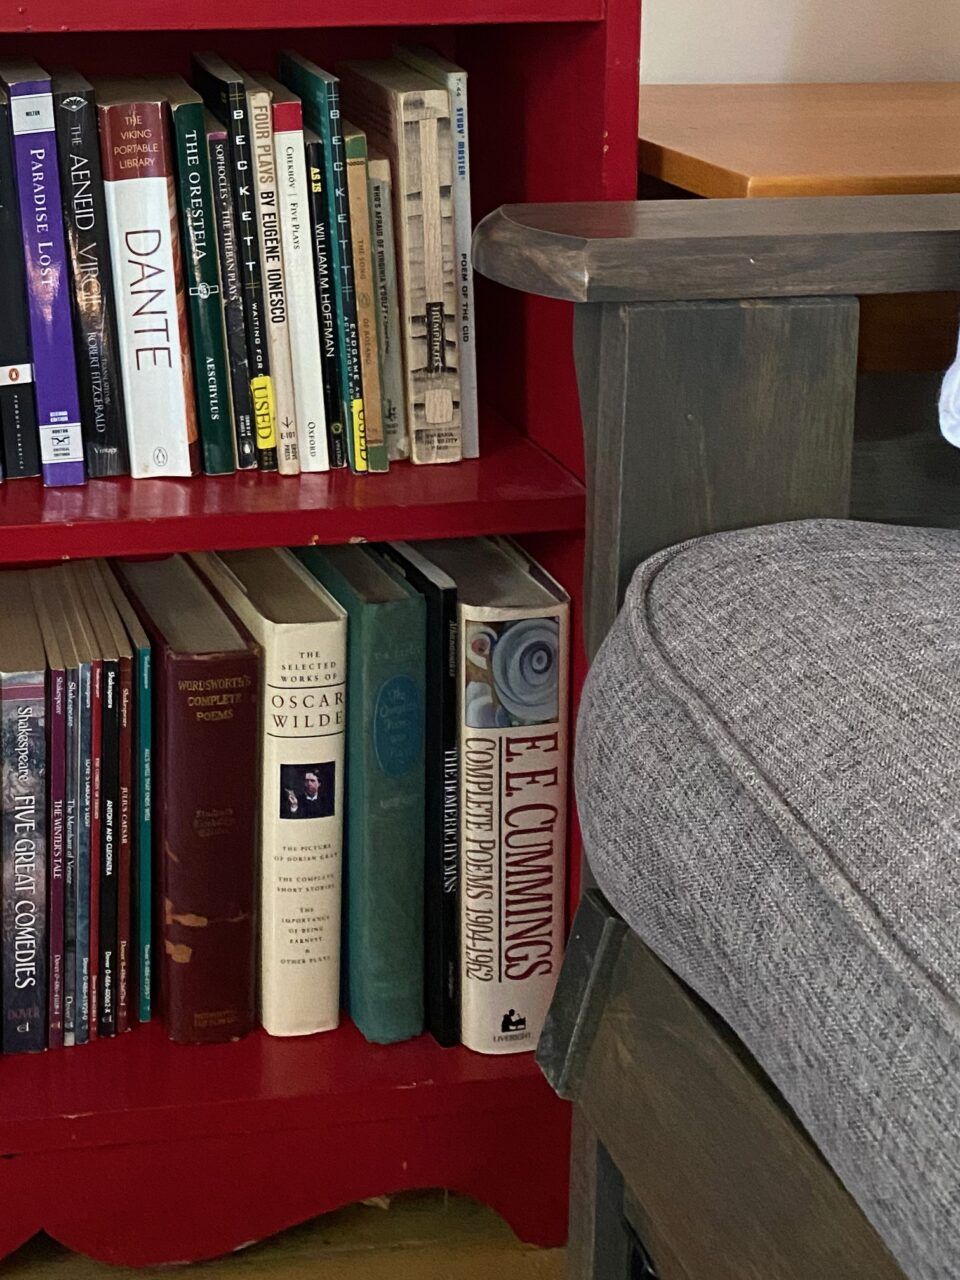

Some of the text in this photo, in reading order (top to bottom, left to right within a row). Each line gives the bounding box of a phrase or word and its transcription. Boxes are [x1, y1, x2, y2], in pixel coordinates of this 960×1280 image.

[112, 142, 160, 156] PORTABLE
[120, 128, 152, 140] VIKING
[125, 114, 143, 126] THE
[69, 153, 96, 231] AENEID
[118, 156, 156, 169] LIBRARY
[184, 130, 207, 261] THE ORESTEIA
[30, 149, 60, 286] PARADISE LOST
[253, 105, 286, 325] FOUR PLAYS BY EUGENE IONESCO
[125, 229, 173, 371] DANTE
[205, 356, 220, 420] AESCHYLUS
[253, 384, 273, 440] USED
[271, 691, 345, 710] OSCAR
[272, 711, 344, 730] WILDE
[14, 705, 37, 989] Shakespeare FIVE GREAT COMEDIES
[464, 737, 497, 982] COMPLETE POEMS 1904-1962
[503, 803, 559, 981] CUMMINGS
